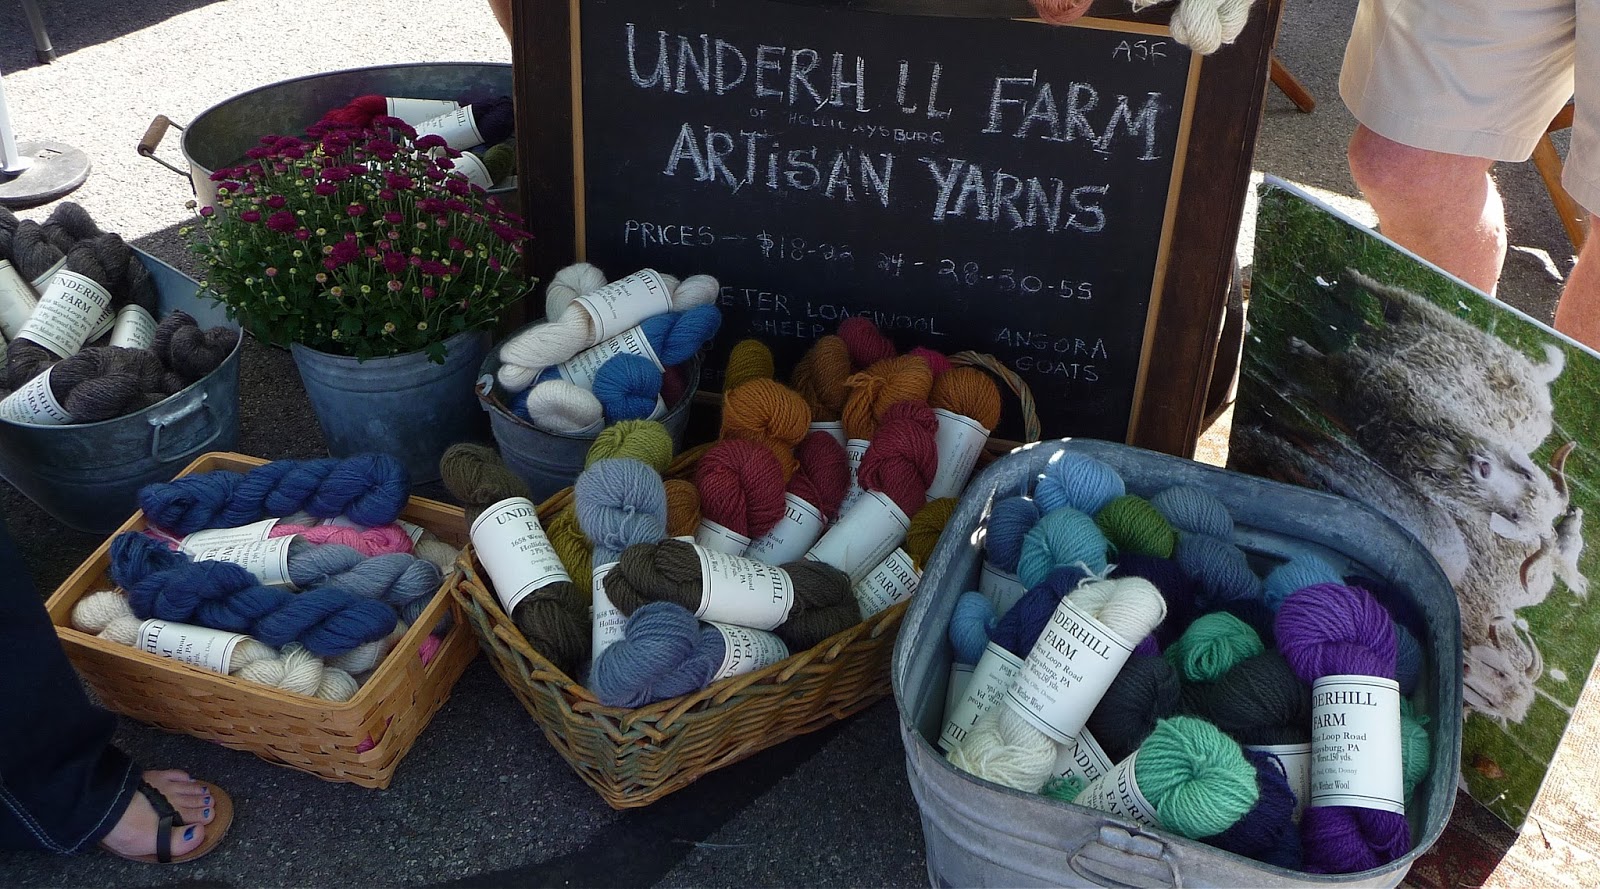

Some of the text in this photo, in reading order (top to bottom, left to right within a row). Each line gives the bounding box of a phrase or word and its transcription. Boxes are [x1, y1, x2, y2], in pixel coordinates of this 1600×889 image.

[626, 22, 1163, 161] UNDERHLL FARM
[918, 156, 1111, 234] YARNS
[60, 291, 92, 314] FARM
[719, 286, 791, 316] ETER
[66, 307, 83, 321] Loop
[748, 318, 825, 339] SHEEP
[994, 327, 1108, 359] ANGORA
[1015, 356, 1099, 382] GOATS
[525, 521, 541, 531] FA
[511, 537, 527, 548] 1658
[765, 541, 775, 550] PA
[767, 532, 784, 545] Road
[739, 574, 746, 584] PA
[747, 572, 755, 591] Road
[766, 565, 782, 603] RHILL
[873, 571, 903, 602] FARM
[873, 589, 888, 606] Loop
[1050, 608, 1114, 661] NDERHILL
[176, 635, 187, 655] Road
[185, 642, 193, 653] PA
[722, 625, 742, 679] UNDER
[1043, 629, 1079, 662] FARM
[999, 664, 1013, 677] Wool
[1045, 651, 1063, 670] Loop
[1062, 664, 1083, 683] Road
[1059, 676, 1072, 688] PA
[975, 688, 986, 699] PA
[1313, 691, 1377, 709] DERHILL
[967, 695, 984, 710] Road
[1028, 697, 1044, 713] Wool
[1314, 713, 1346, 730] FARM
[1322, 733, 1340, 742] Loop
[1343, 732, 1367, 741] Road
[1347, 743, 1360, 752] PA
[1117, 757, 1155, 828] UNDERH
[1334, 781, 1350, 790] Wool
